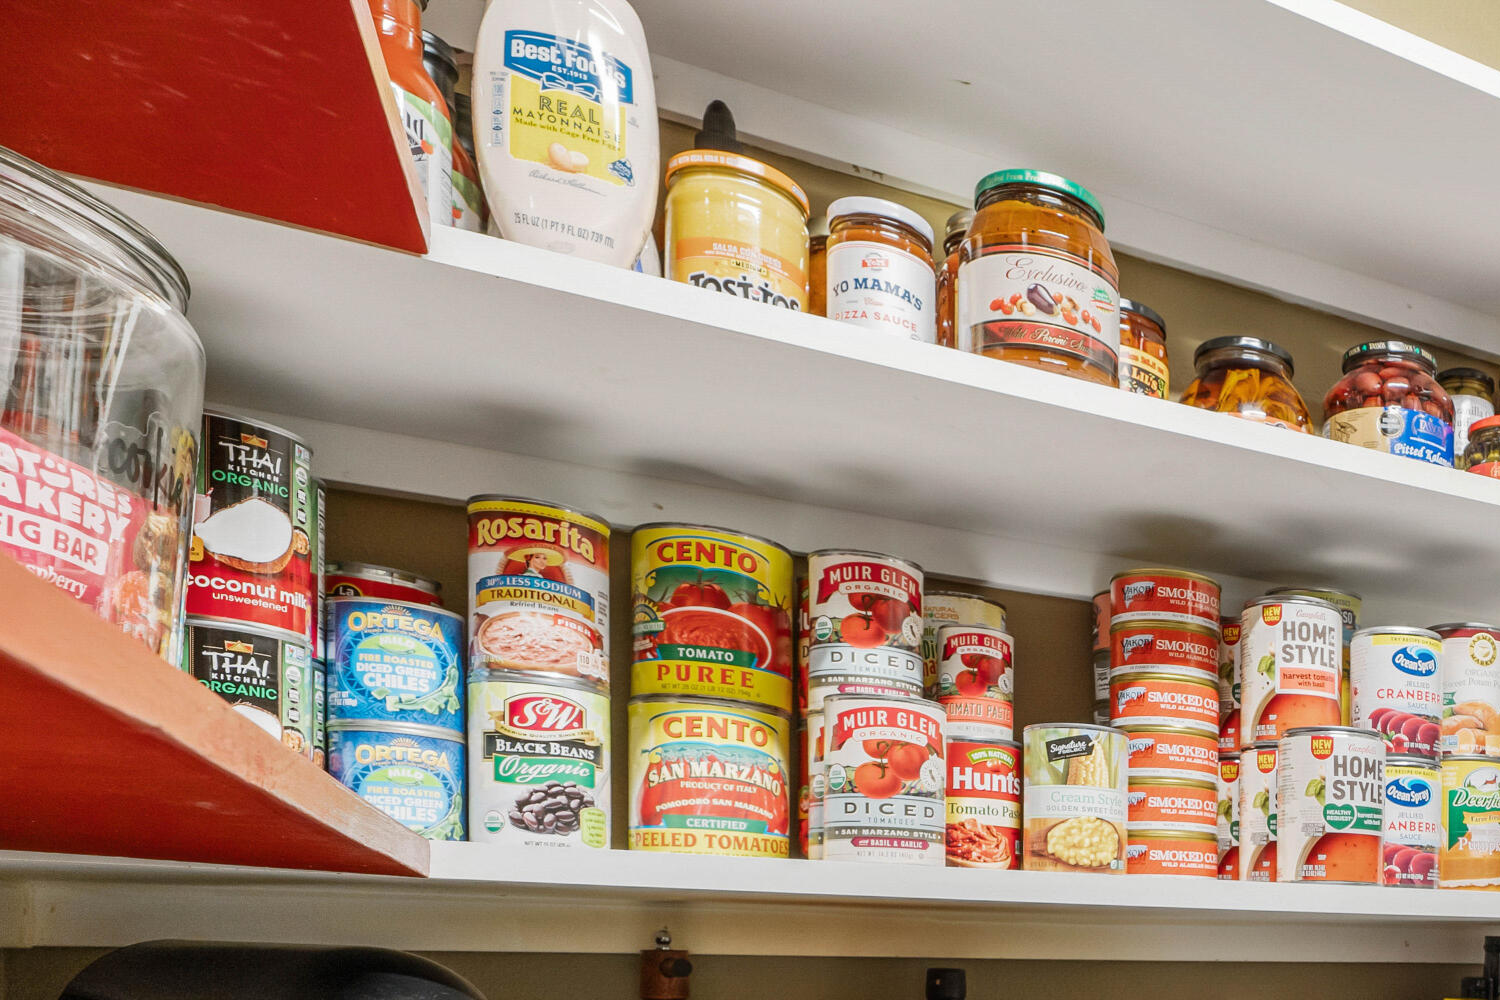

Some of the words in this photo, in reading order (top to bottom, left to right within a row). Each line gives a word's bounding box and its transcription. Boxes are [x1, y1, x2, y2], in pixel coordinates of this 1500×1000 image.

[511, 38, 561, 65] Best
[539, 95, 600, 126] REAL
[512, 108, 621, 143] MAYONNAISE
[832, 280, 849, 298] YO
[853, 277, 923, 312] MAMA'S
[835, 309, 867, 321] PIZZA
[873, 311, 918, 333] SAUCE
[1029, 327, 1070, 347] Porcini
[219, 441, 282, 476] THAI
[212, 469, 289, 498] ORGANIC
[228, 463, 280, 483] KITCHEN
[53, 528, 99, 567] BAR
[477, 517, 595, 563] Rosarita
[657, 541, 758, 574] CENTO
[187, 574, 277, 600] coconut
[506, 577, 532, 588] LESS
[533, 579, 583, 600] SODIUM
[829, 566, 872, 585] MUIR
[881, 568, 917, 597] GLEN
[845, 584, 905, 598] ORGANIC
[212, 592, 288, 614] unsweetened
[490, 589, 578, 610] TRADITIONAL
[1157, 586, 1209, 604] SMOKED
[1263, 606, 1281, 618] NEW
[348, 611, 445, 643] ORTEGA
[1282, 620, 1335, 648] HOME
[950, 635, 980, 649] MUIR
[202, 650, 270, 679] THAI
[359, 653, 382, 664] FIRE
[384, 656, 434, 669] ROASTED
[677, 647, 734, 662] TOMATO
[831, 651, 915, 671] DICED
[356, 661, 393, 675] DICED
[657, 664, 755, 689] PUREE
[1282, 672, 1312, 681] harvest
[211, 672, 267, 687] KITCHEN
[363, 673, 430, 693] CHILES
[986, 703, 1011, 721] PASTE
[663, 716, 768, 747] CENTO
[843, 711, 888, 731] MUIR
[897, 711, 937, 738] GLEN
[859, 730, 922, 743] ORGANIC
[1050, 740, 1087, 754] Signature
[1312, 739, 1332, 750] NEW
[355, 744, 451, 772] ORTEGA
[495, 738, 547, 755] BLACK
[549, 742, 595, 760] BEANS
[387, 768, 425, 782] MILD
[499, 754, 591, 783] Organic
[690, 760, 781, 797] MARZANO
[1333, 755, 1383, 782] HOME
[952, 766, 1021, 795] Hunt's
[367, 785, 389, 796] FIRE
[392, 786, 442, 800] ROASTED
[1332, 779, 1383, 804] STYLE
[402, 796, 444, 810] GREEN
[844, 802, 935, 818] DICED
[948, 802, 999, 816] Tomato
[1147, 796, 1202, 810] SMOKED
[686, 818, 748, 830] CERTIFIED
[862, 829, 910, 838] MARZANO
[913, 831, 937, 840] STYLE
[635, 831, 697, 848] PEELED
[704, 834, 789, 856] TOMATOES
[870, 840, 891, 848] BASIL
[1149, 849, 1203, 862] SMOKED
